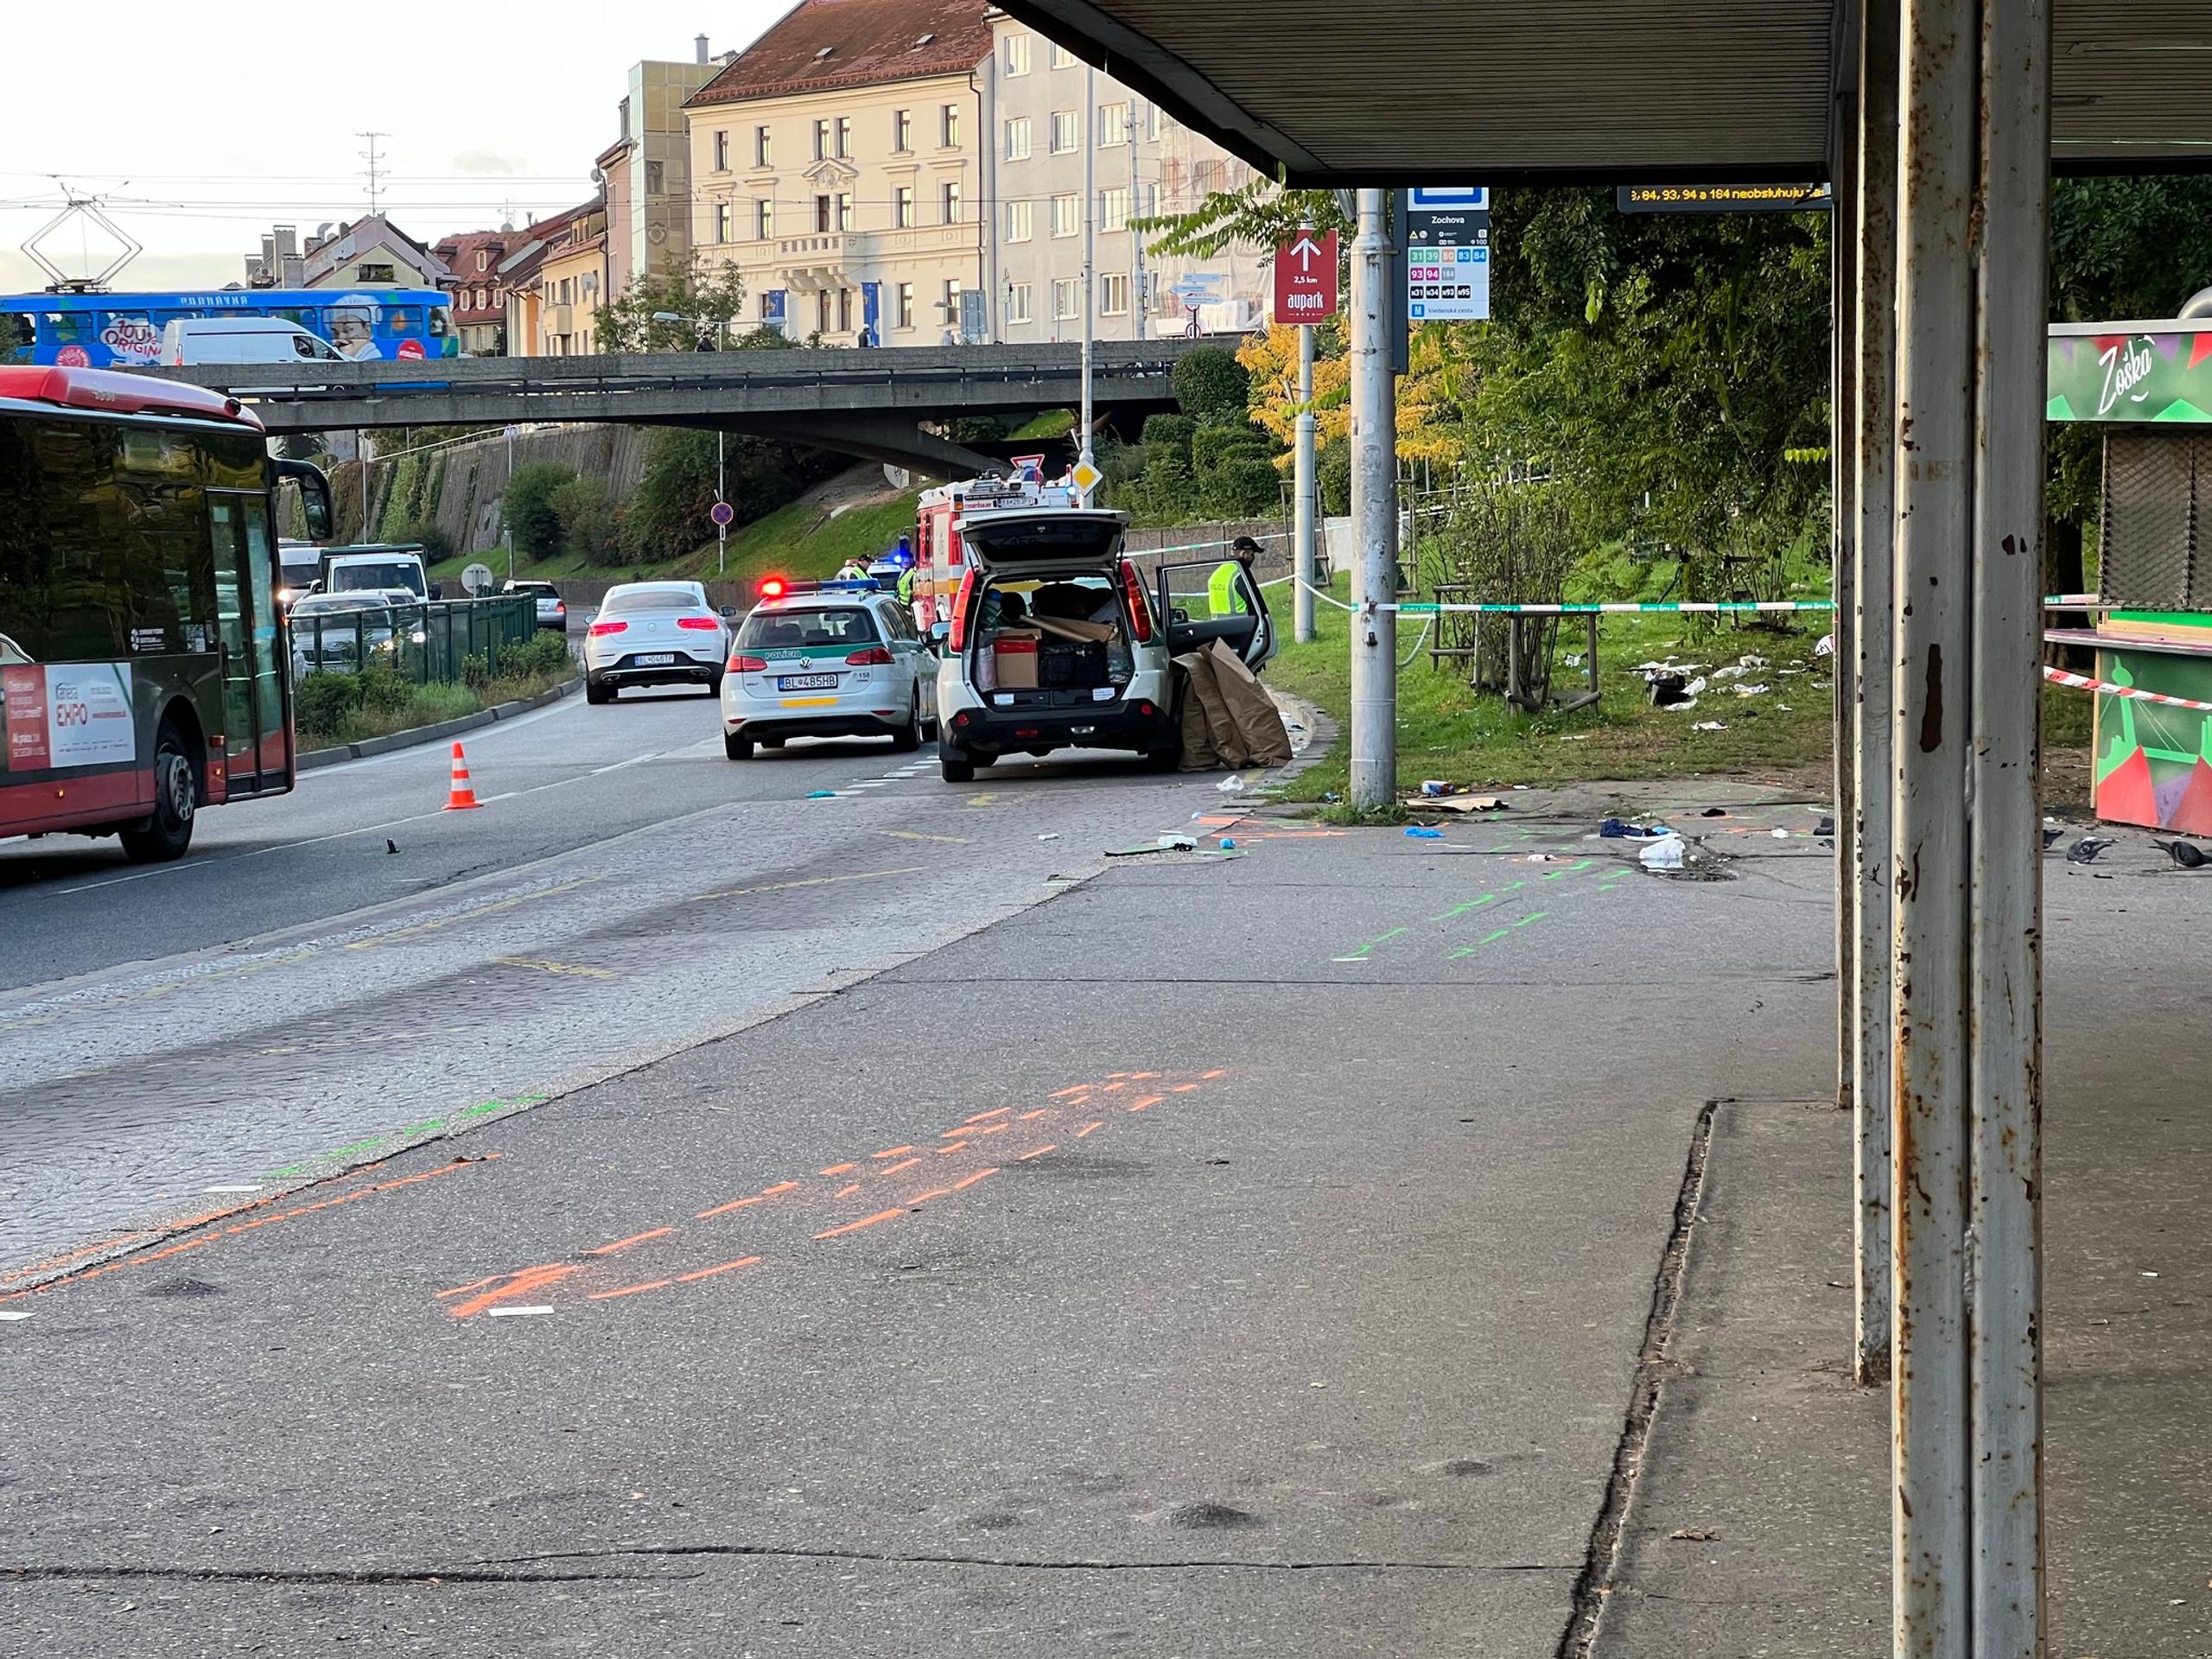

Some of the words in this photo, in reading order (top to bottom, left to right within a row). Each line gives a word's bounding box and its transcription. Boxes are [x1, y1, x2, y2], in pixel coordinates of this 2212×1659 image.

[1642, 190, 1661, 201] 84,
[1662, 189, 1681, 200] 93,
[1682, 189, 1697, 200] 94
[1710, 188, 1730, 200] 184
[1411, 251, 1423, 260] 31
[1427, 251, 1439, 260] 39
[1443, 251, 1454, 260] 80
[1459, 251, 1470, 260] 83
[1474, 251, 1485, 260] 84
[1294, 276, 1306, 284] 2,5
[1411, 270, 1423, 279] 93
[1427, 270, 1439, 279] 94
[1287, 291, 1324, 311] aupark
[57, 703, 87, 727] EXPO
